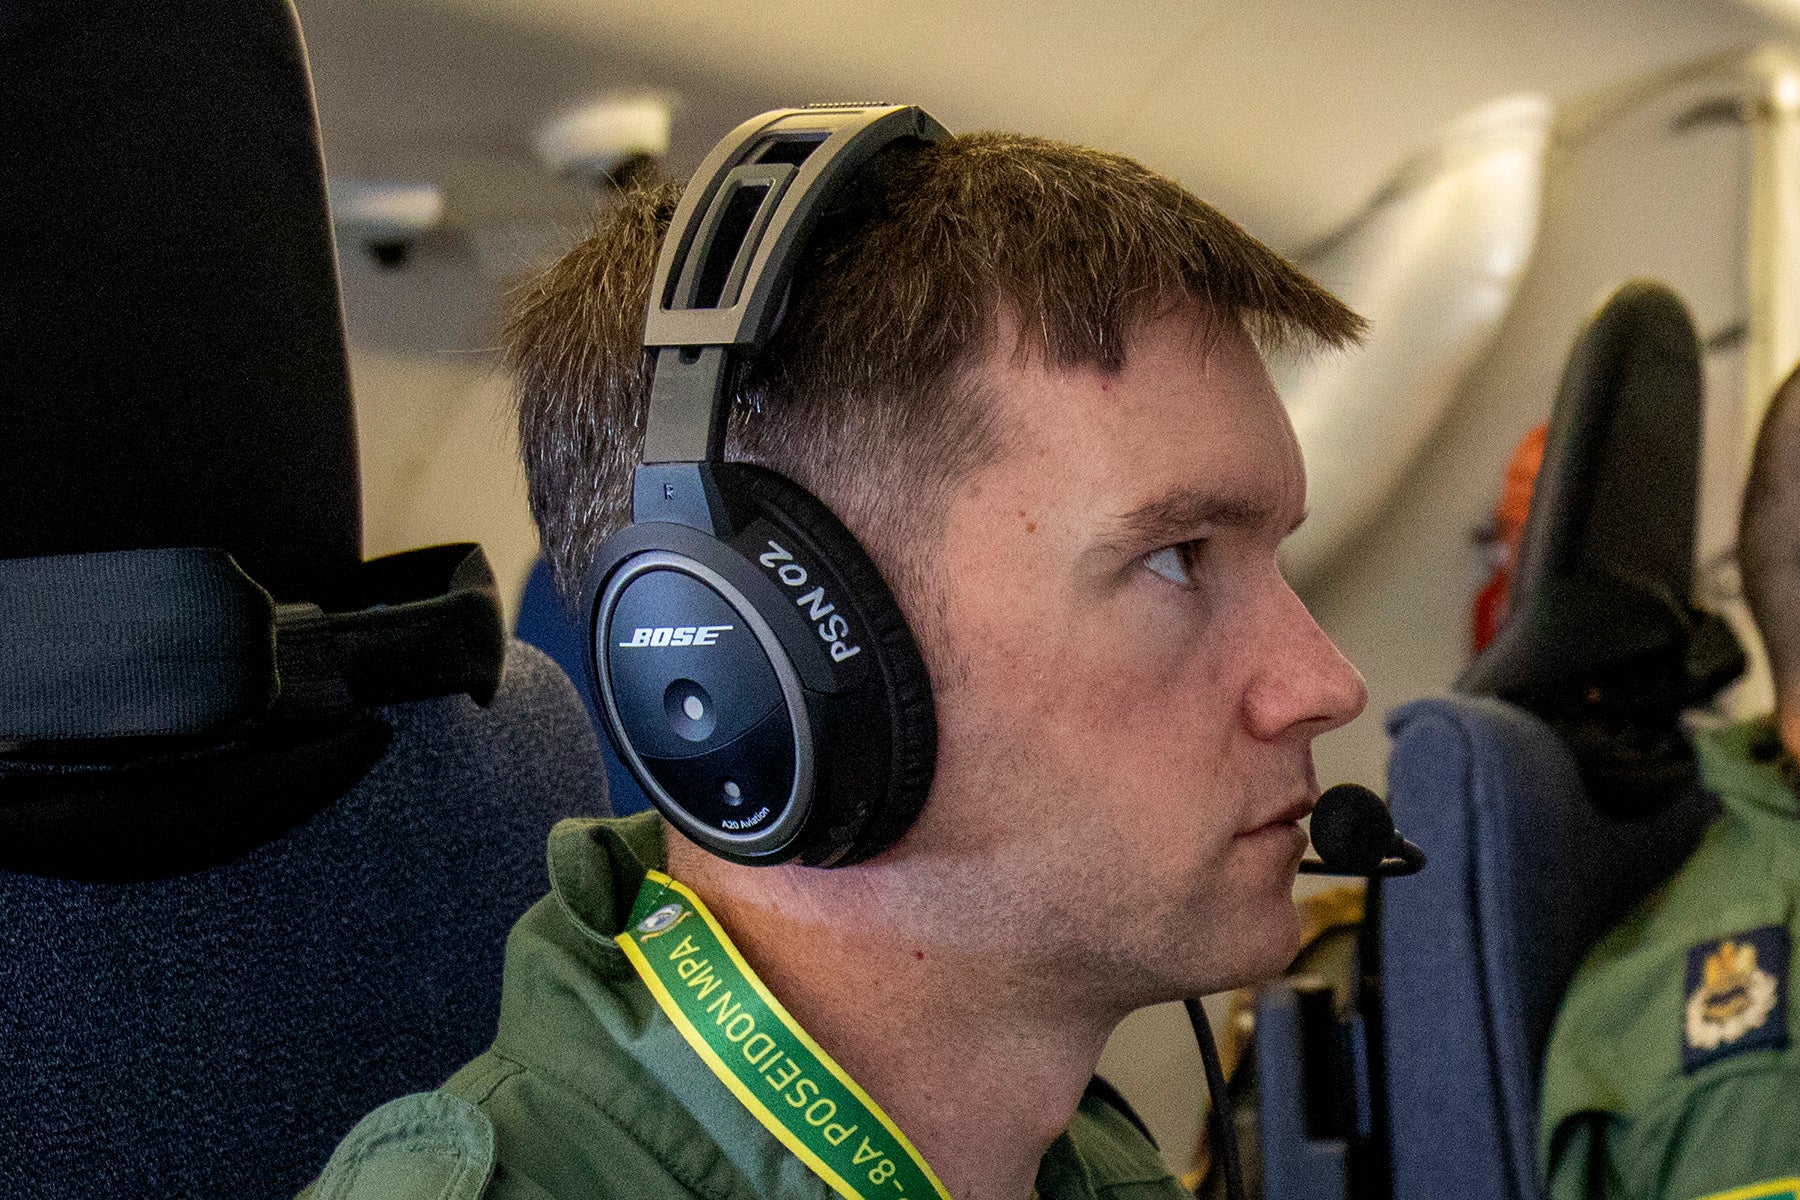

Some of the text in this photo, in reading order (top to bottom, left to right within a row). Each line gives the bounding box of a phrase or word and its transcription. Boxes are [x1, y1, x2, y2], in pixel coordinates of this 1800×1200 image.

[664, 483, 674, 500] R
[759, 539, 861, 664] PSN 02
[619, 624, 734, 648] BOSE
[721, 806, 770, 831] A20 Aviation
[668, 934, 724, 995] MPA
[715, 993, 860, 1147] POSEIDON
